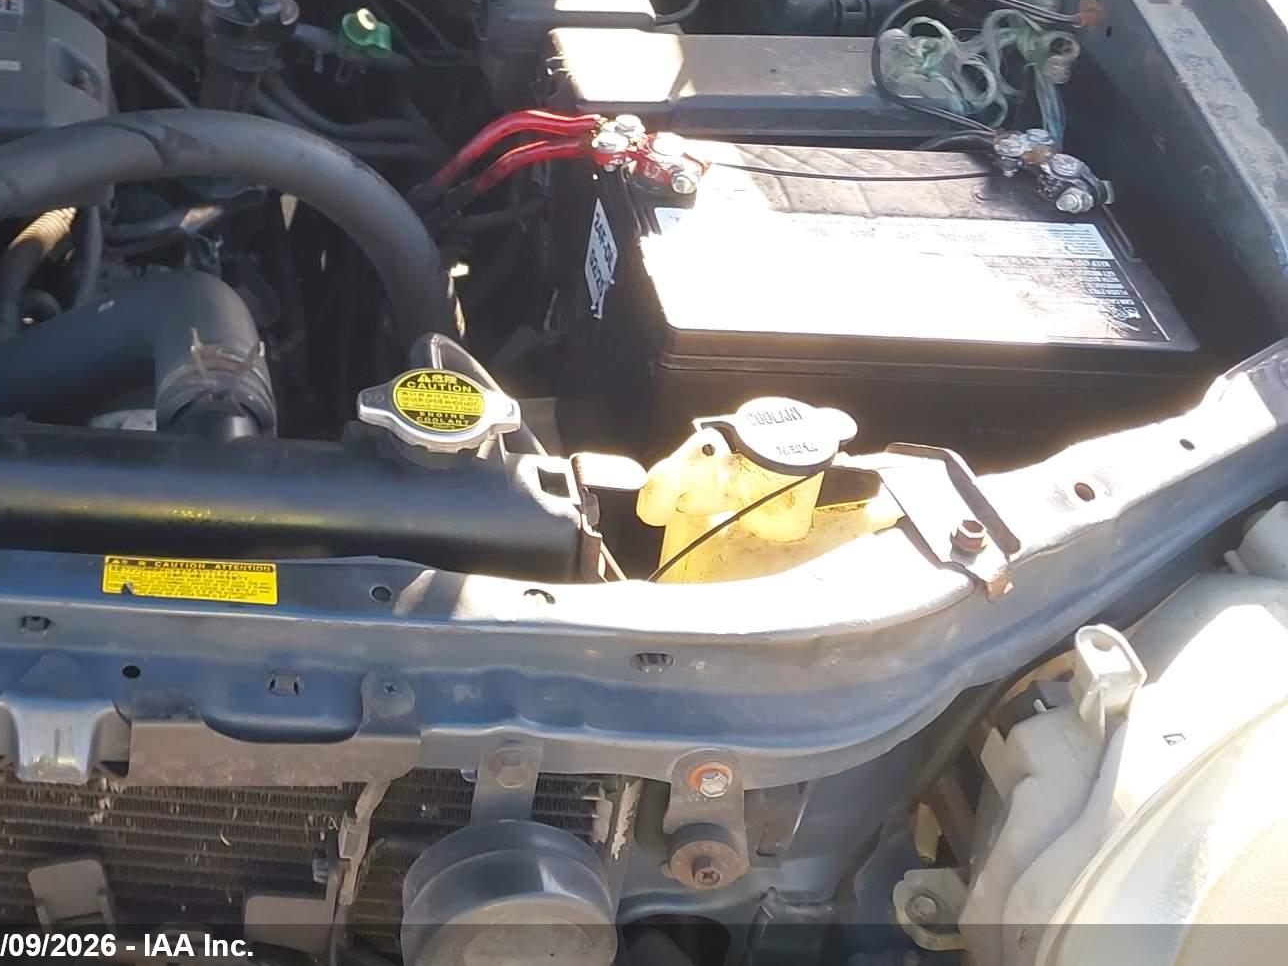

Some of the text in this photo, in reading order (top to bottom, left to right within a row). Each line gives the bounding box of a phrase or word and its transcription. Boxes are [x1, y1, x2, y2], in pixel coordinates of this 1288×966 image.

[406, 381, 472, 393] CAUTION
[416, 416, 470, 426] COOLANT
[419, 411, 465, 420] ENGINE
[154, 561, 206, 570] CAUTION
[214, 564, 271, 573] ATTENTION
